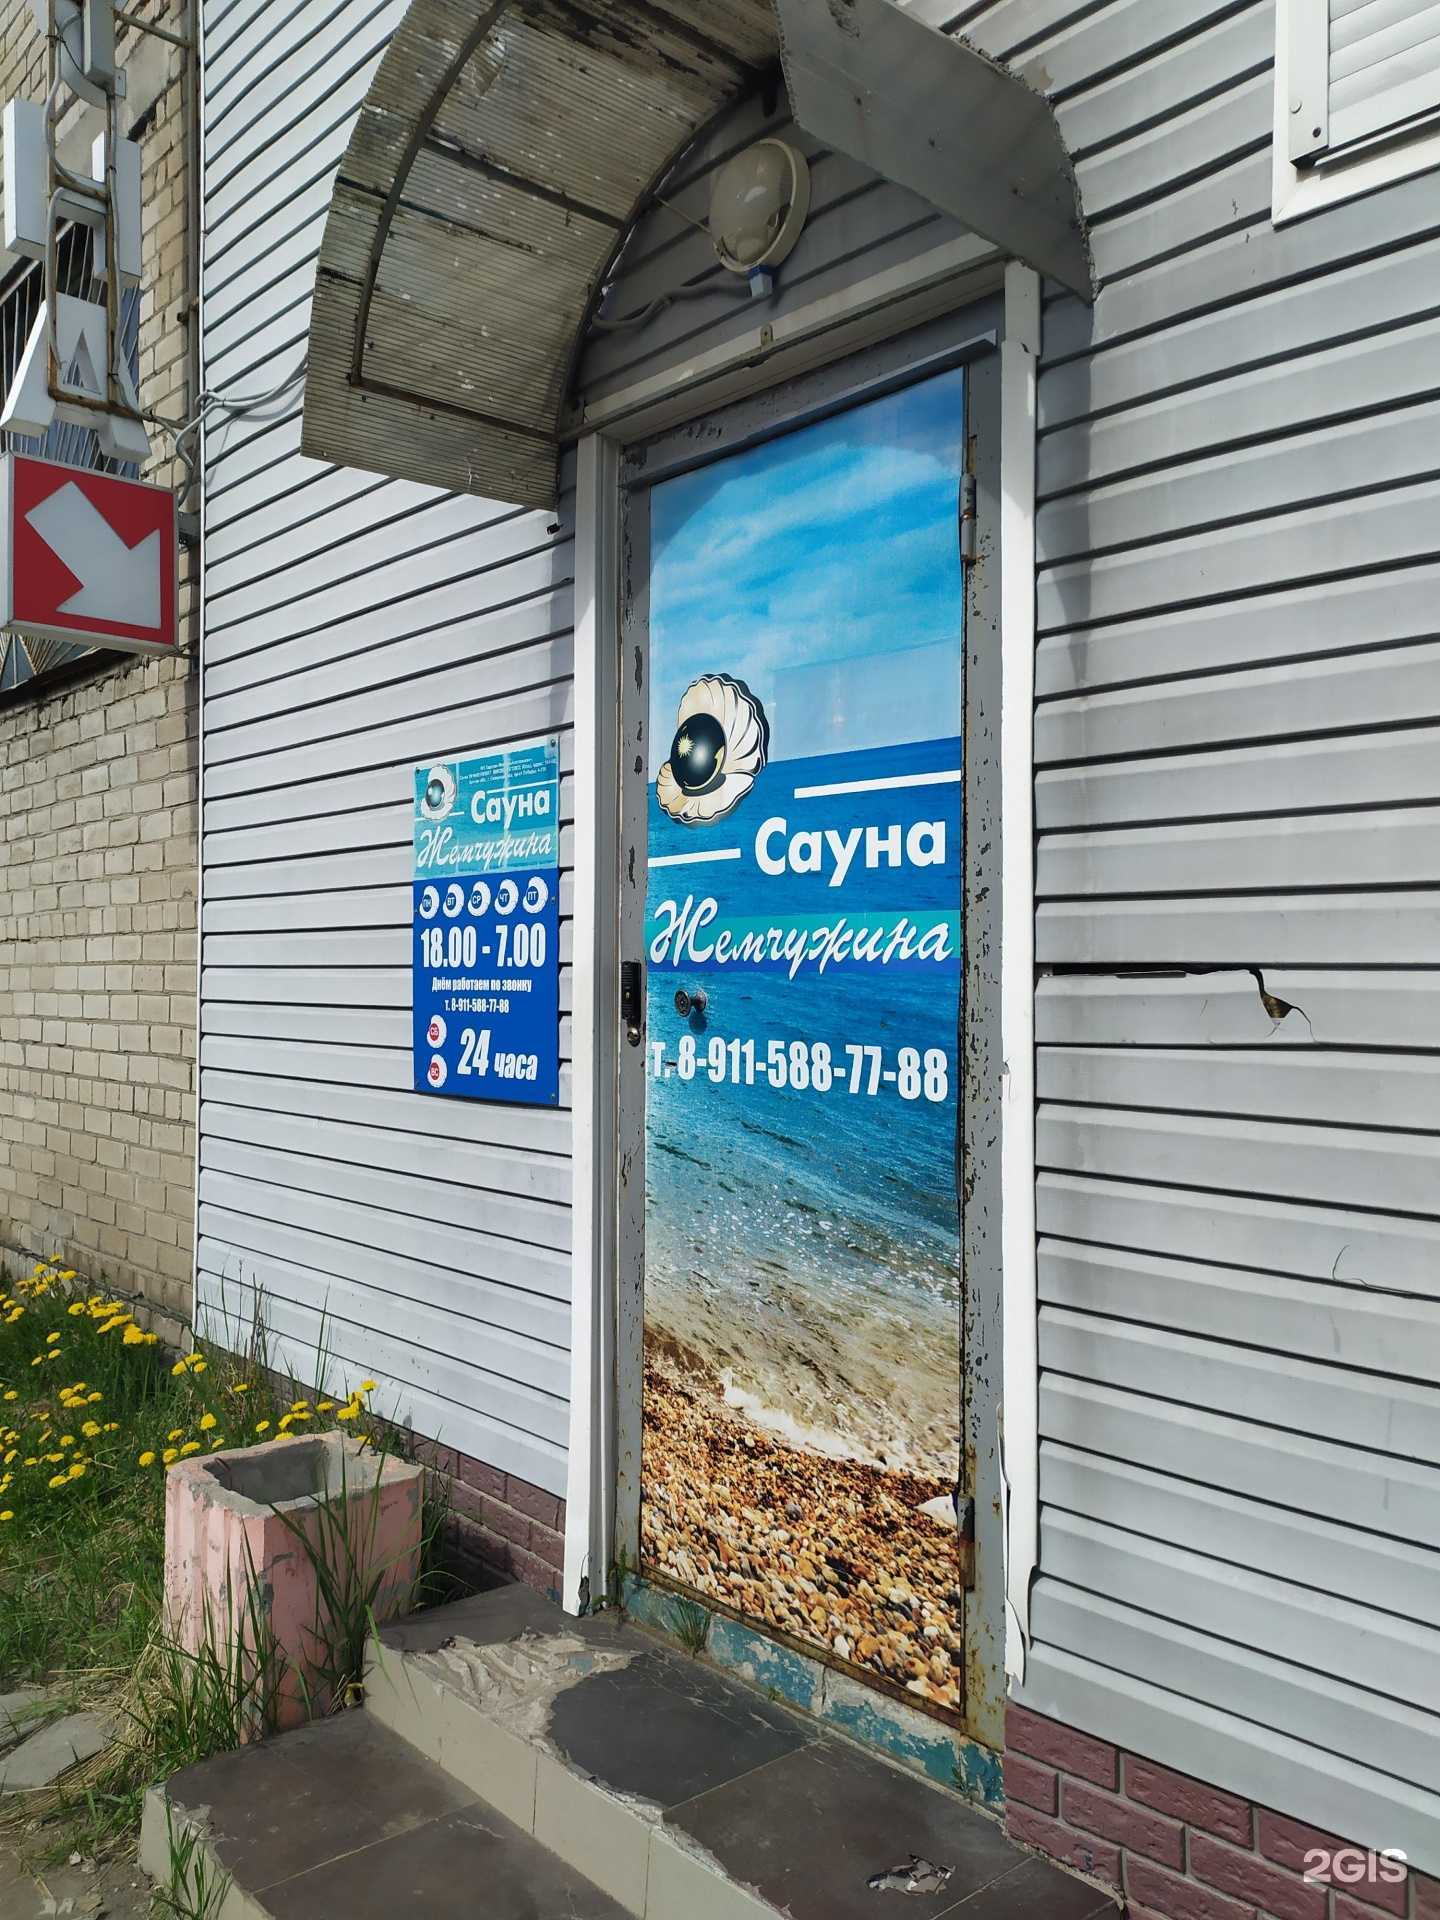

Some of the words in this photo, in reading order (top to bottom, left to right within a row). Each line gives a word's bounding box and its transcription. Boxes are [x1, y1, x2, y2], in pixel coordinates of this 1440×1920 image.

[471, 790, 550, 829] Сауна
[417, 826, 553, 870] Жемчужина
[755, 817, 947, 887] Сауна
[471, 895, 481, 905] СР
[527, 891, 537, 901] ПТ
[421, 924, 477, 968] 18.00
[496, 922, 546, 967] 7.00
[650, 895, 953, 981] Жемчужина
[452, 977, 490, 992] работаем
[490, 979, 501, 991] по
[502, 979, 532, 993] звонку
[457, 1028, 491, 1077] 24
[494, 1051, 539, 1081] часа
